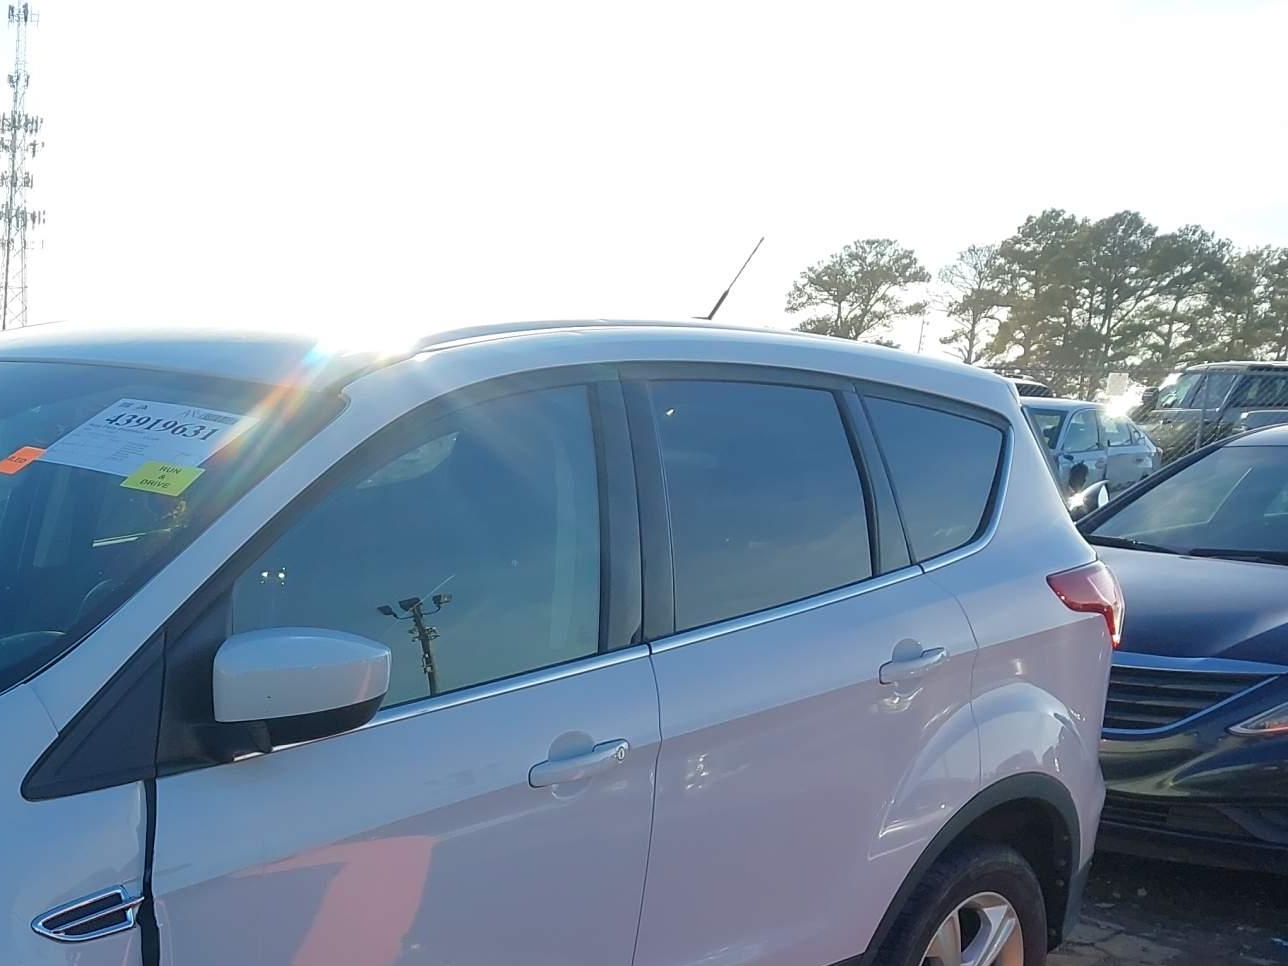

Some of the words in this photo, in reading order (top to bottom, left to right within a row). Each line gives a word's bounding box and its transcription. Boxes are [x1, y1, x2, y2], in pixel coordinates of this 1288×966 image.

[106, 413, 218, 440] 43919631
[159, 465, 182, 474] RUN
[139, 478, 170, 489] DRIVE
